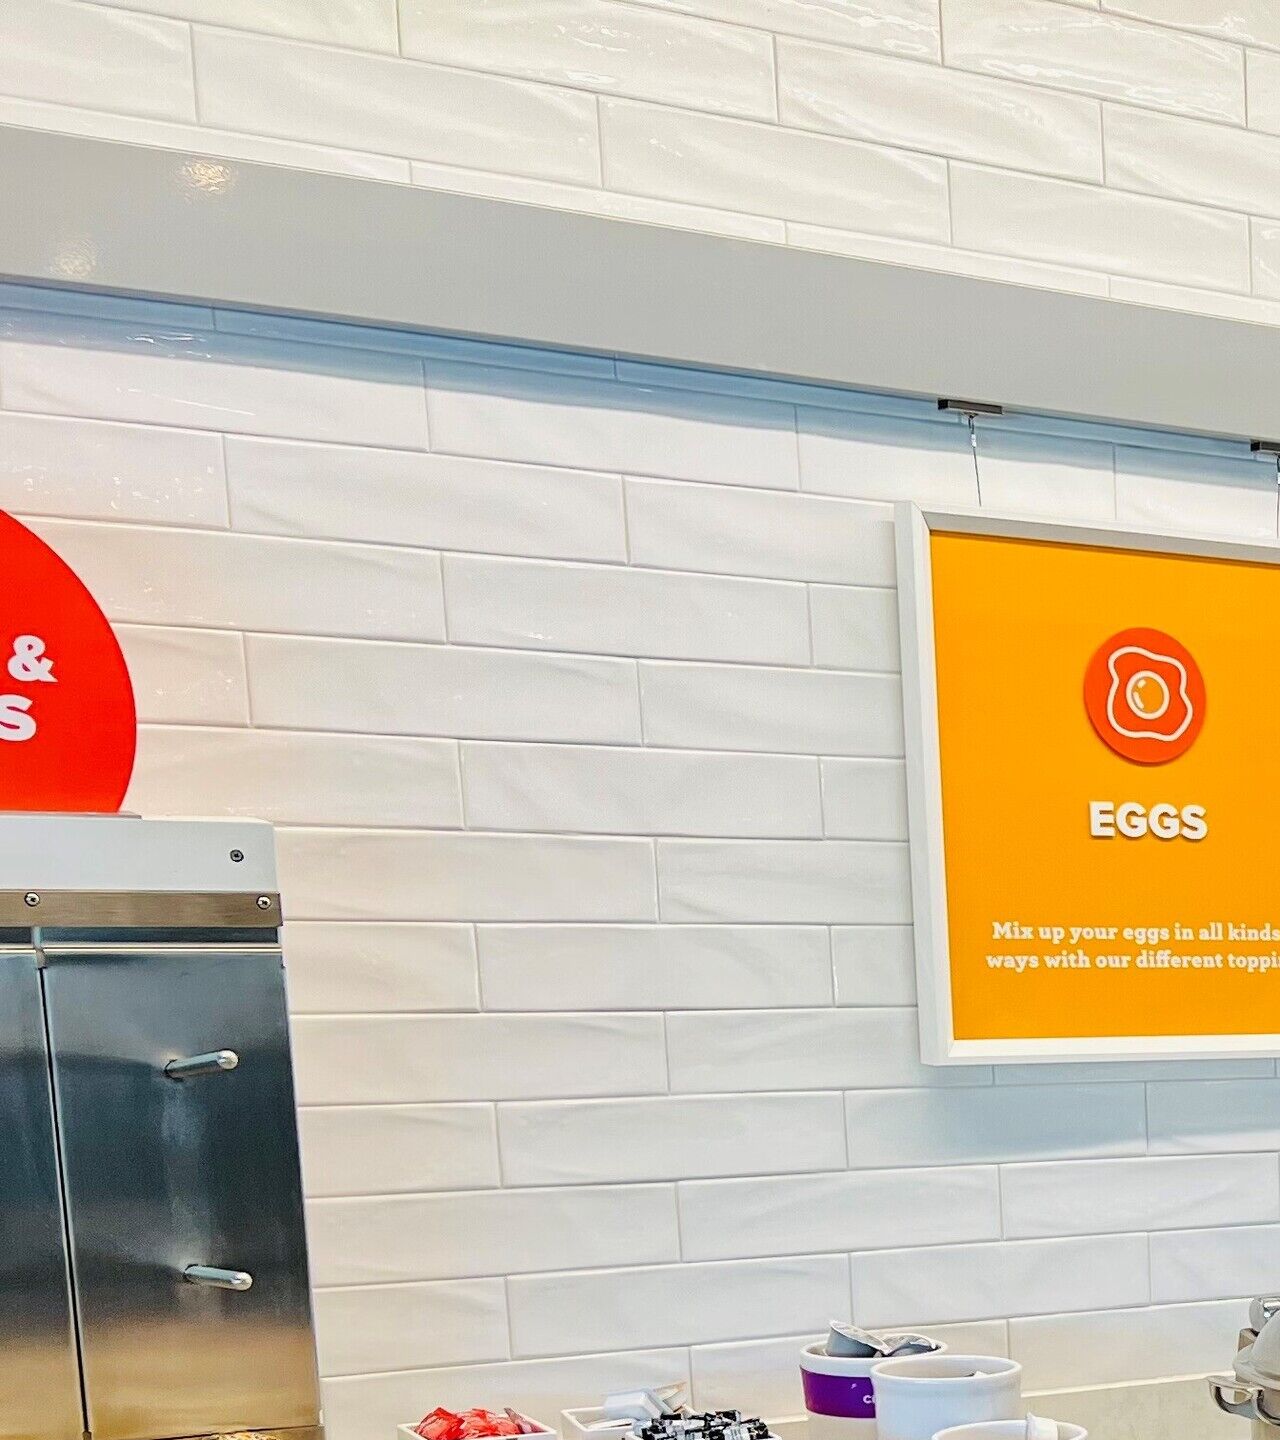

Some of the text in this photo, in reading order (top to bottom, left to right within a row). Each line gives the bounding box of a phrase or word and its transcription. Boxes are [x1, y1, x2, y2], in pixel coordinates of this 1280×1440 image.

[7, 634, 58, 683] &
[1088, 800, 1208, 841] EGGS
[992, 921, 1034, 940] Mix
[1038, 927, 1065, 944] up
[1069, 927, 1118, 944] your
[1122, 927, 1170, 945] eggs
[1175, 923, 1195, 940] in
[1199, 922, 1224, 941] all
[1228, 923, 1280, 942] kinds
[985, 954, 1039, 973] ways
[1044, 950, 1091, 969] with
[1095, 954, 1131, 969] our
[1136, 950, 1223, 969] different
